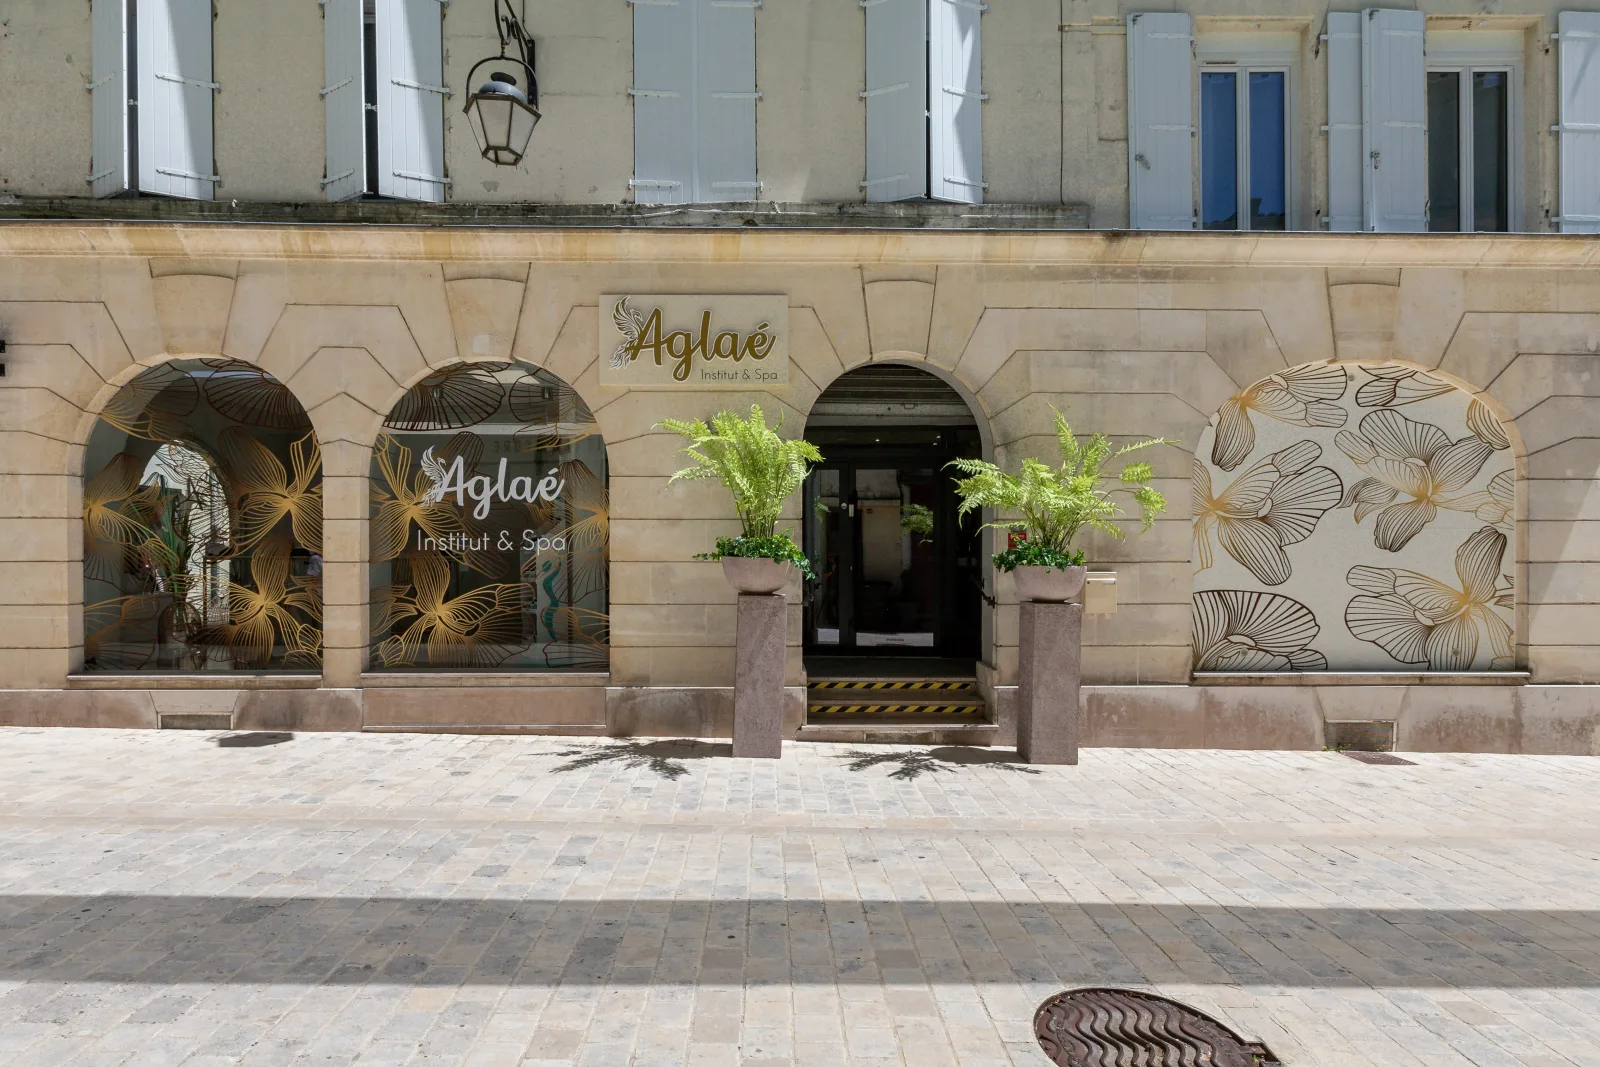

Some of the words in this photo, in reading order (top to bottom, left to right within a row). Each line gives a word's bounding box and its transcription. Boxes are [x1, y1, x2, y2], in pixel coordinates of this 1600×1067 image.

[627, 307, 777, 382] Aglaé
[701, 369, 738, 380] Institut
[742, 369, 751, 380] &
[755, 369, 778, 382] Spa
[436, 455, 566, 520] Aglaé
[417, 529, 490, 551] Institut
[497, 530, 514, 551] &
[522, 529, 566, 556] Spa
